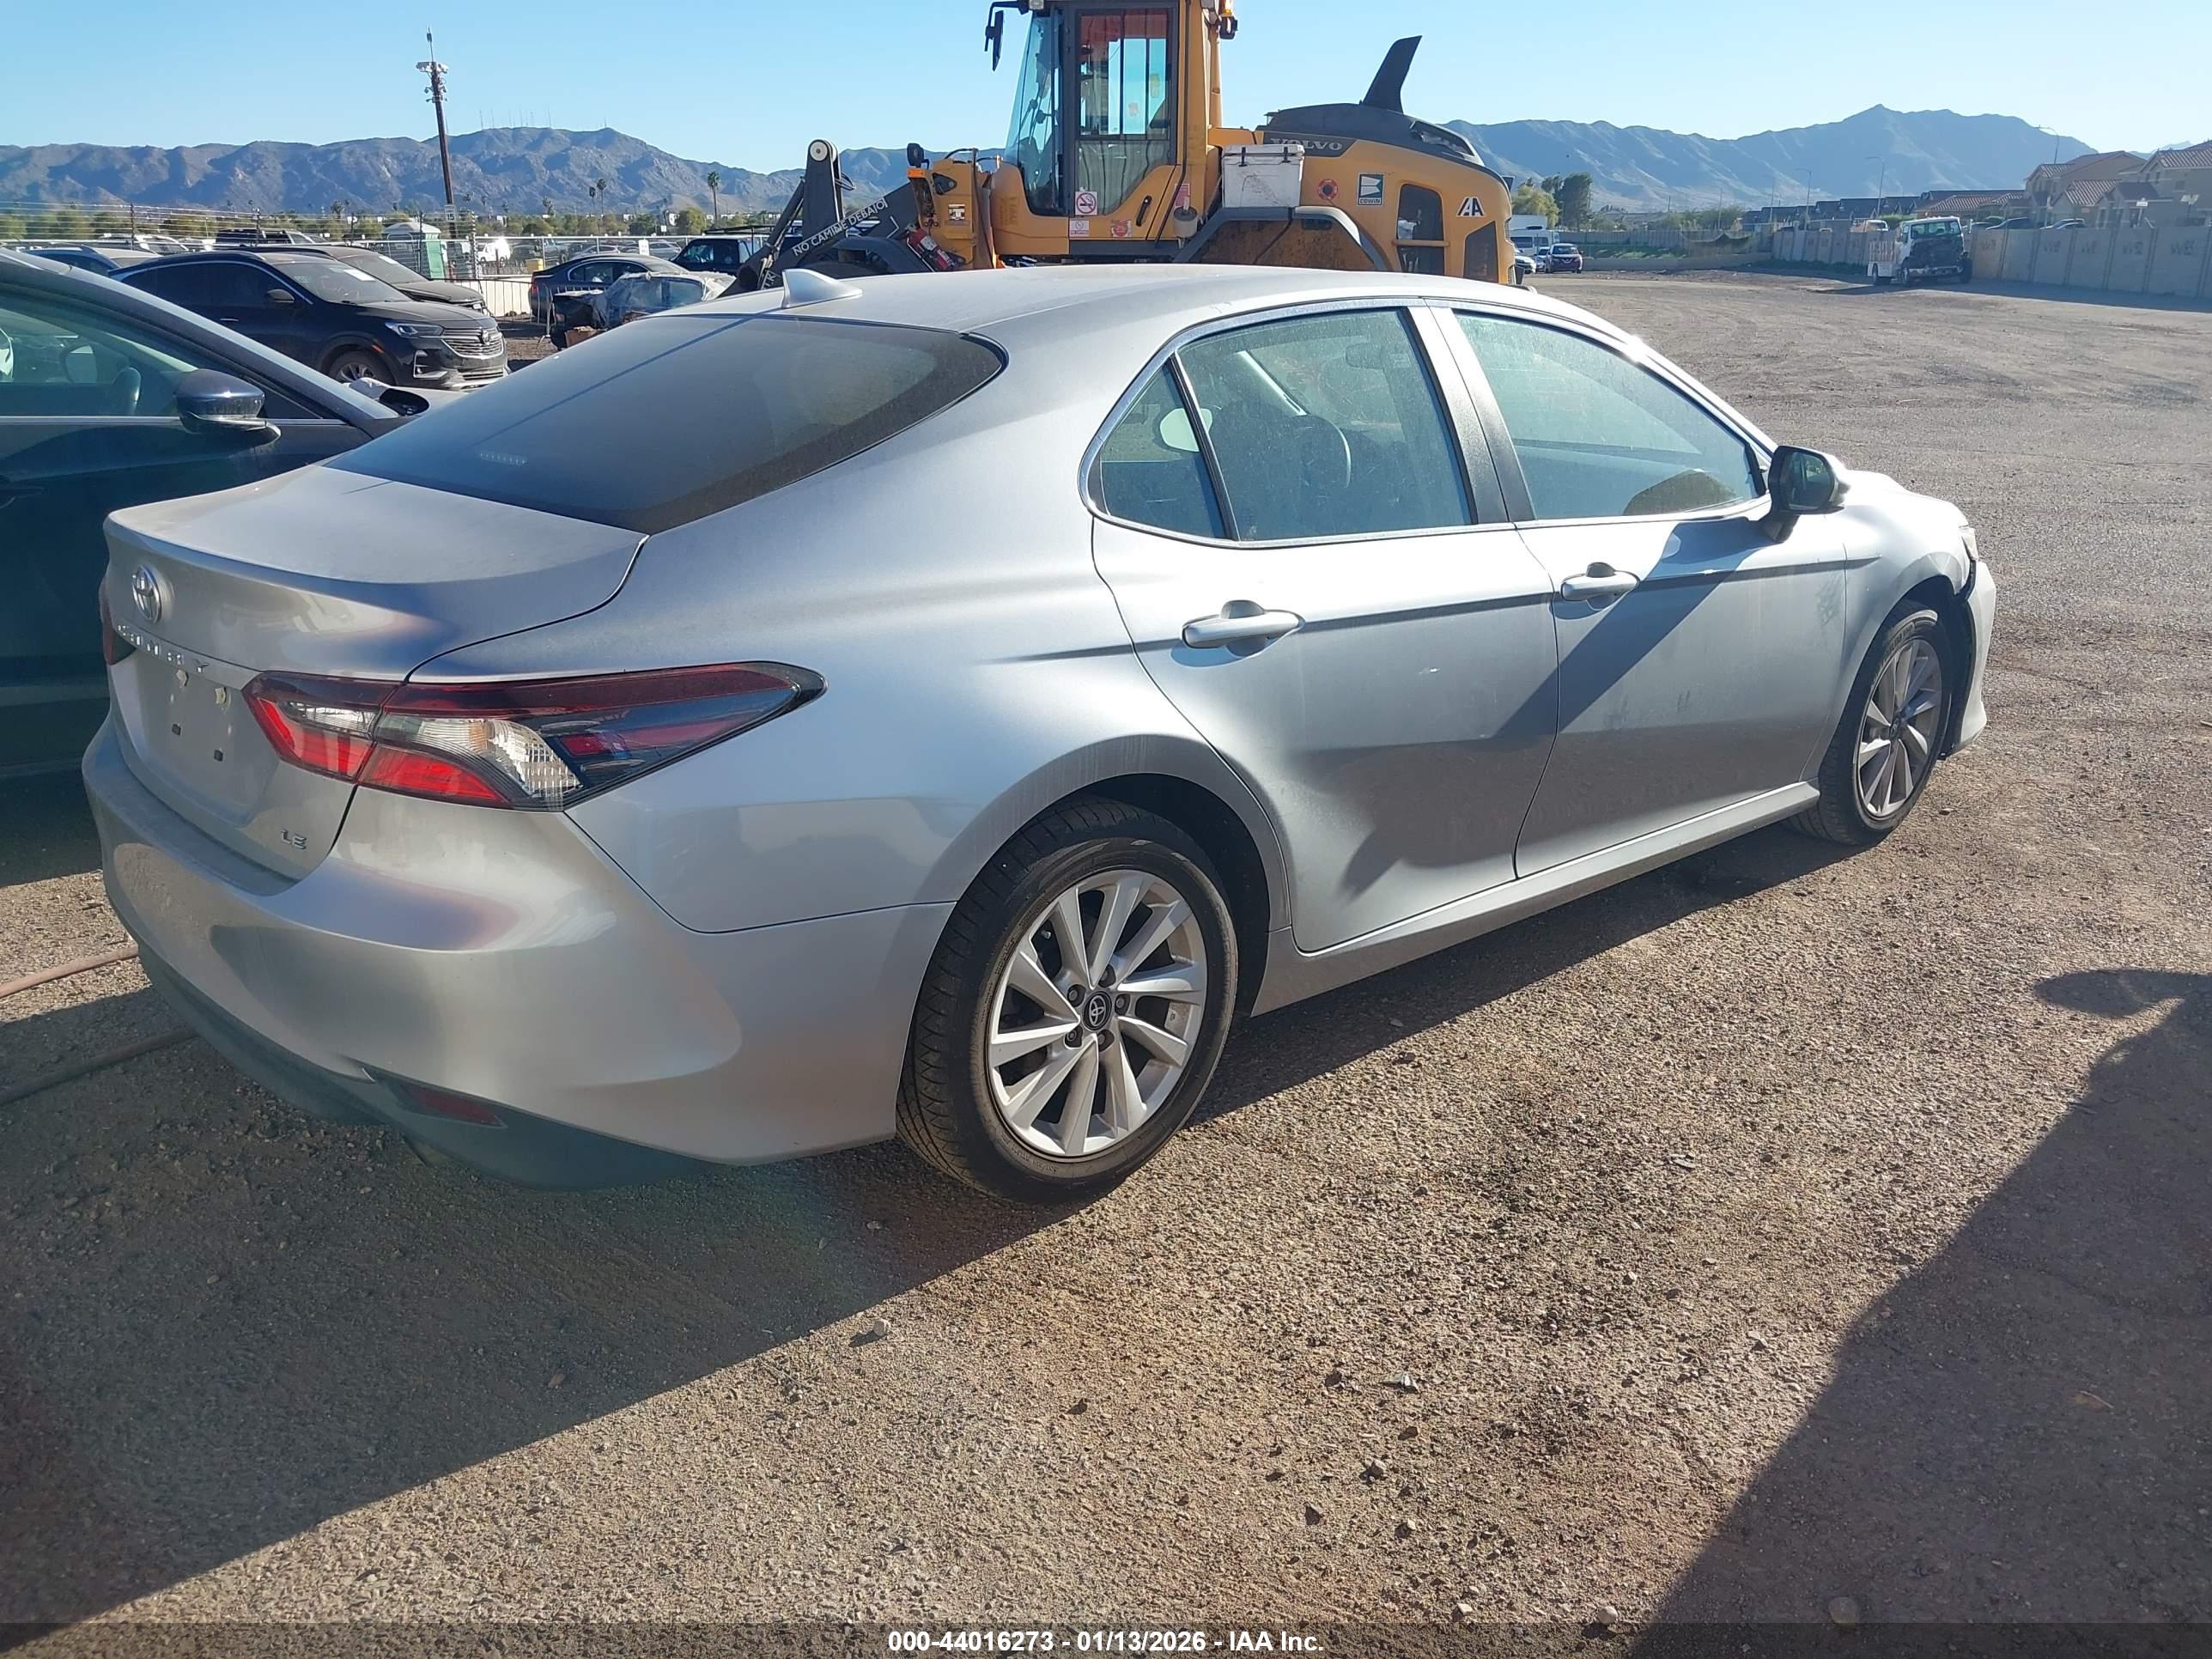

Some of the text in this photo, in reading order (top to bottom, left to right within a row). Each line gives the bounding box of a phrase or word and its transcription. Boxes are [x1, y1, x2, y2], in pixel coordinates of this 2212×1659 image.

[793, 199, 886, 257] NO CAMINE DEBAJO
[281, 829, 307, 850] LE
